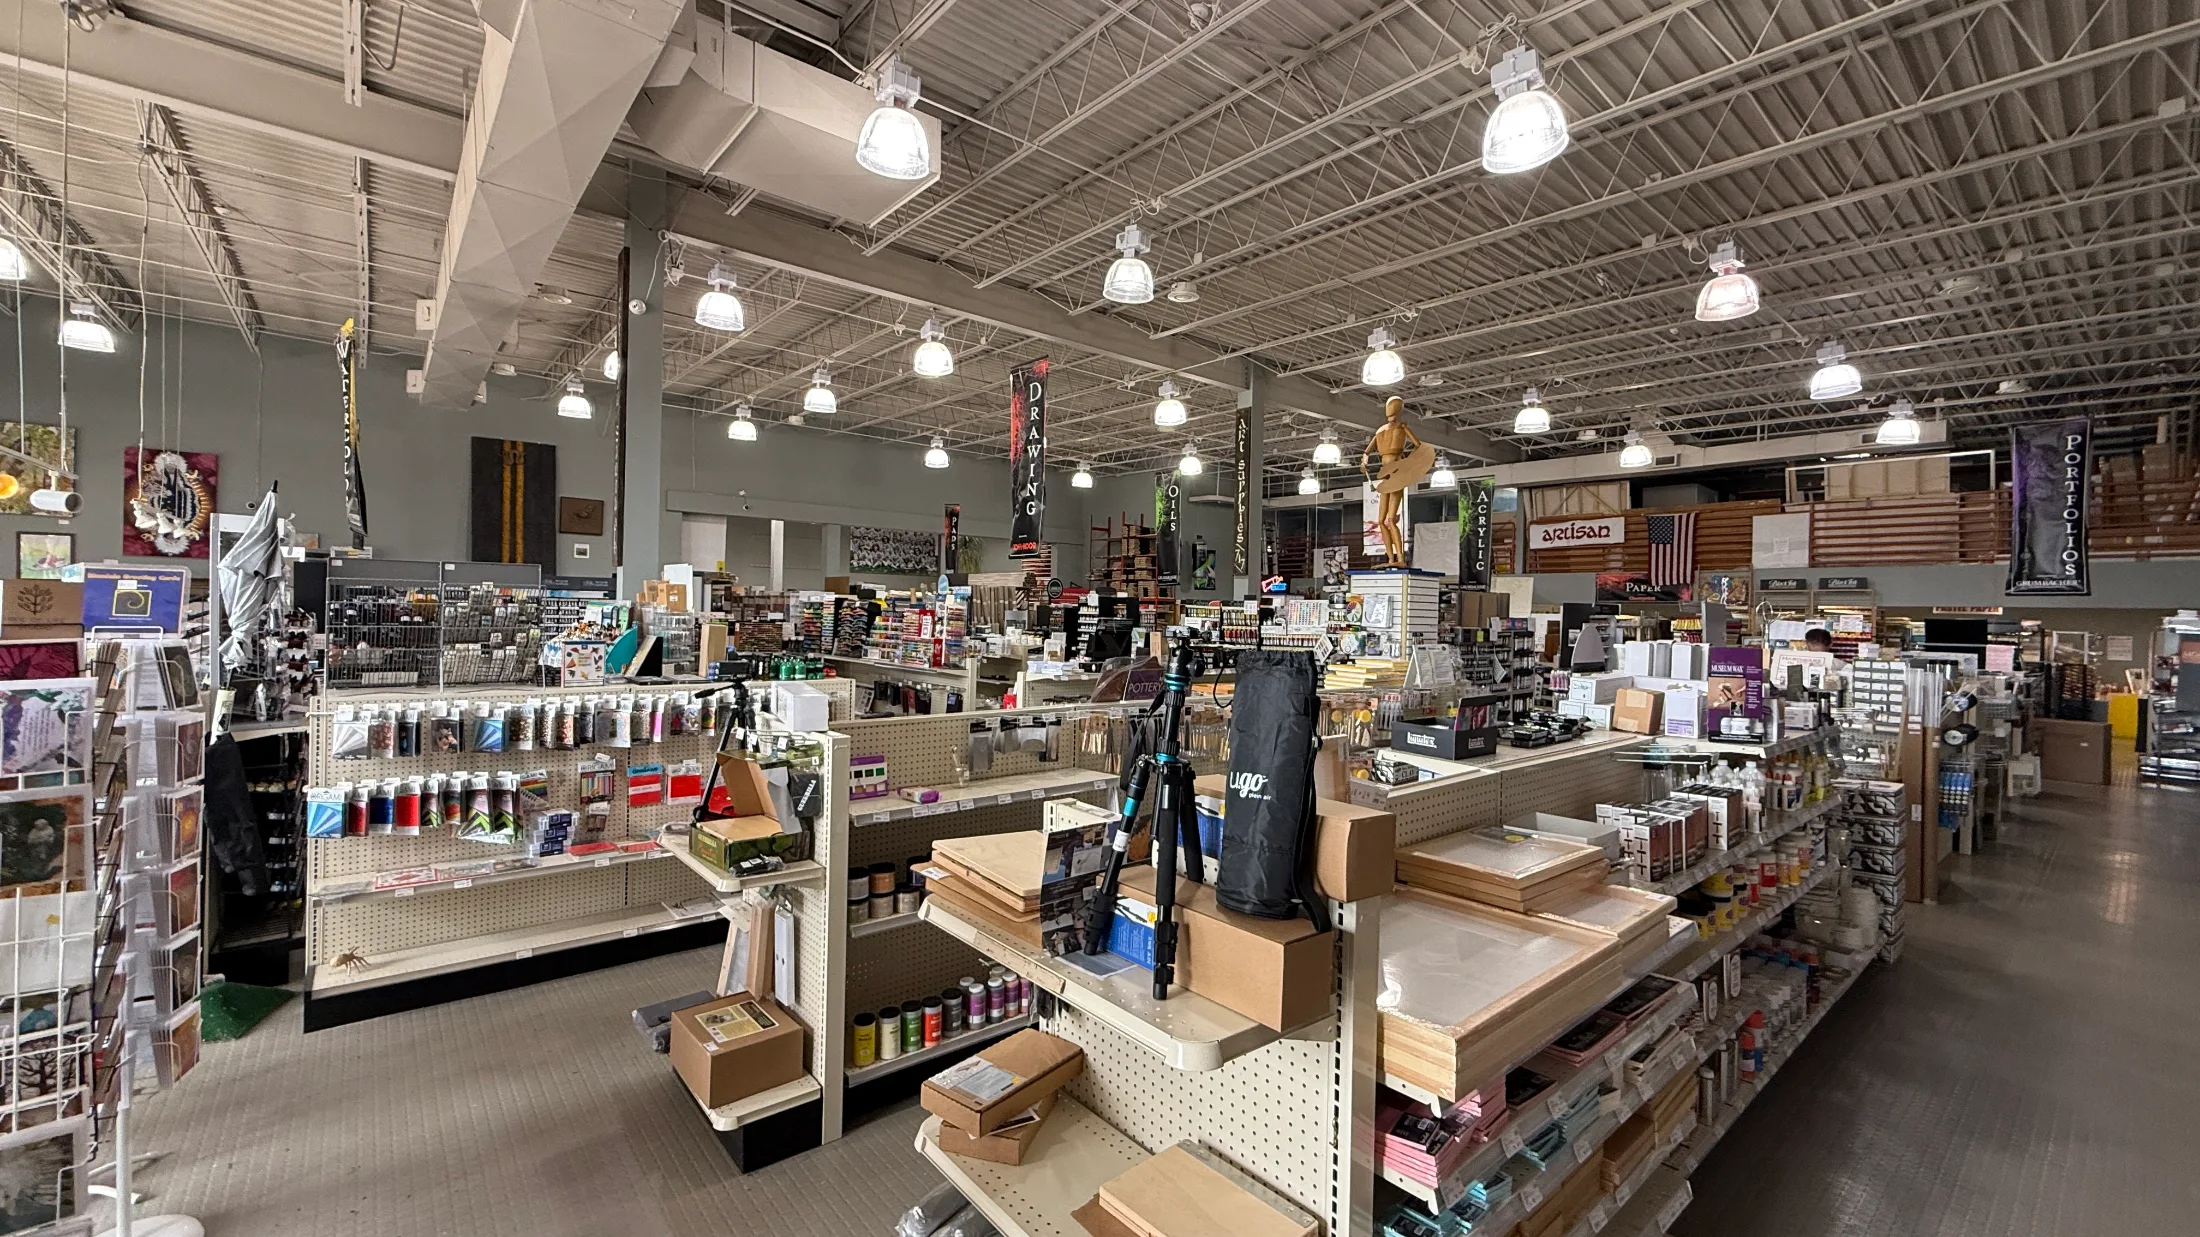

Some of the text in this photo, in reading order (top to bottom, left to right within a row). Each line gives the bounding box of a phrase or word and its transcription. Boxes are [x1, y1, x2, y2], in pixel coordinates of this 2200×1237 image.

[1026, 381, 1042, 516] DRAWING
[1168, 485, 1179, 531] OILS
[1476, 490, 1489, 571] ACRYLIC
[2062, 434, 2082, 576] PORTFOLIOS
[1128, 682, 1164, 693] POTTERY
[1710, 664, 1732, 673] MUSEUM
[1733, 665, 1744, 673] WAX
